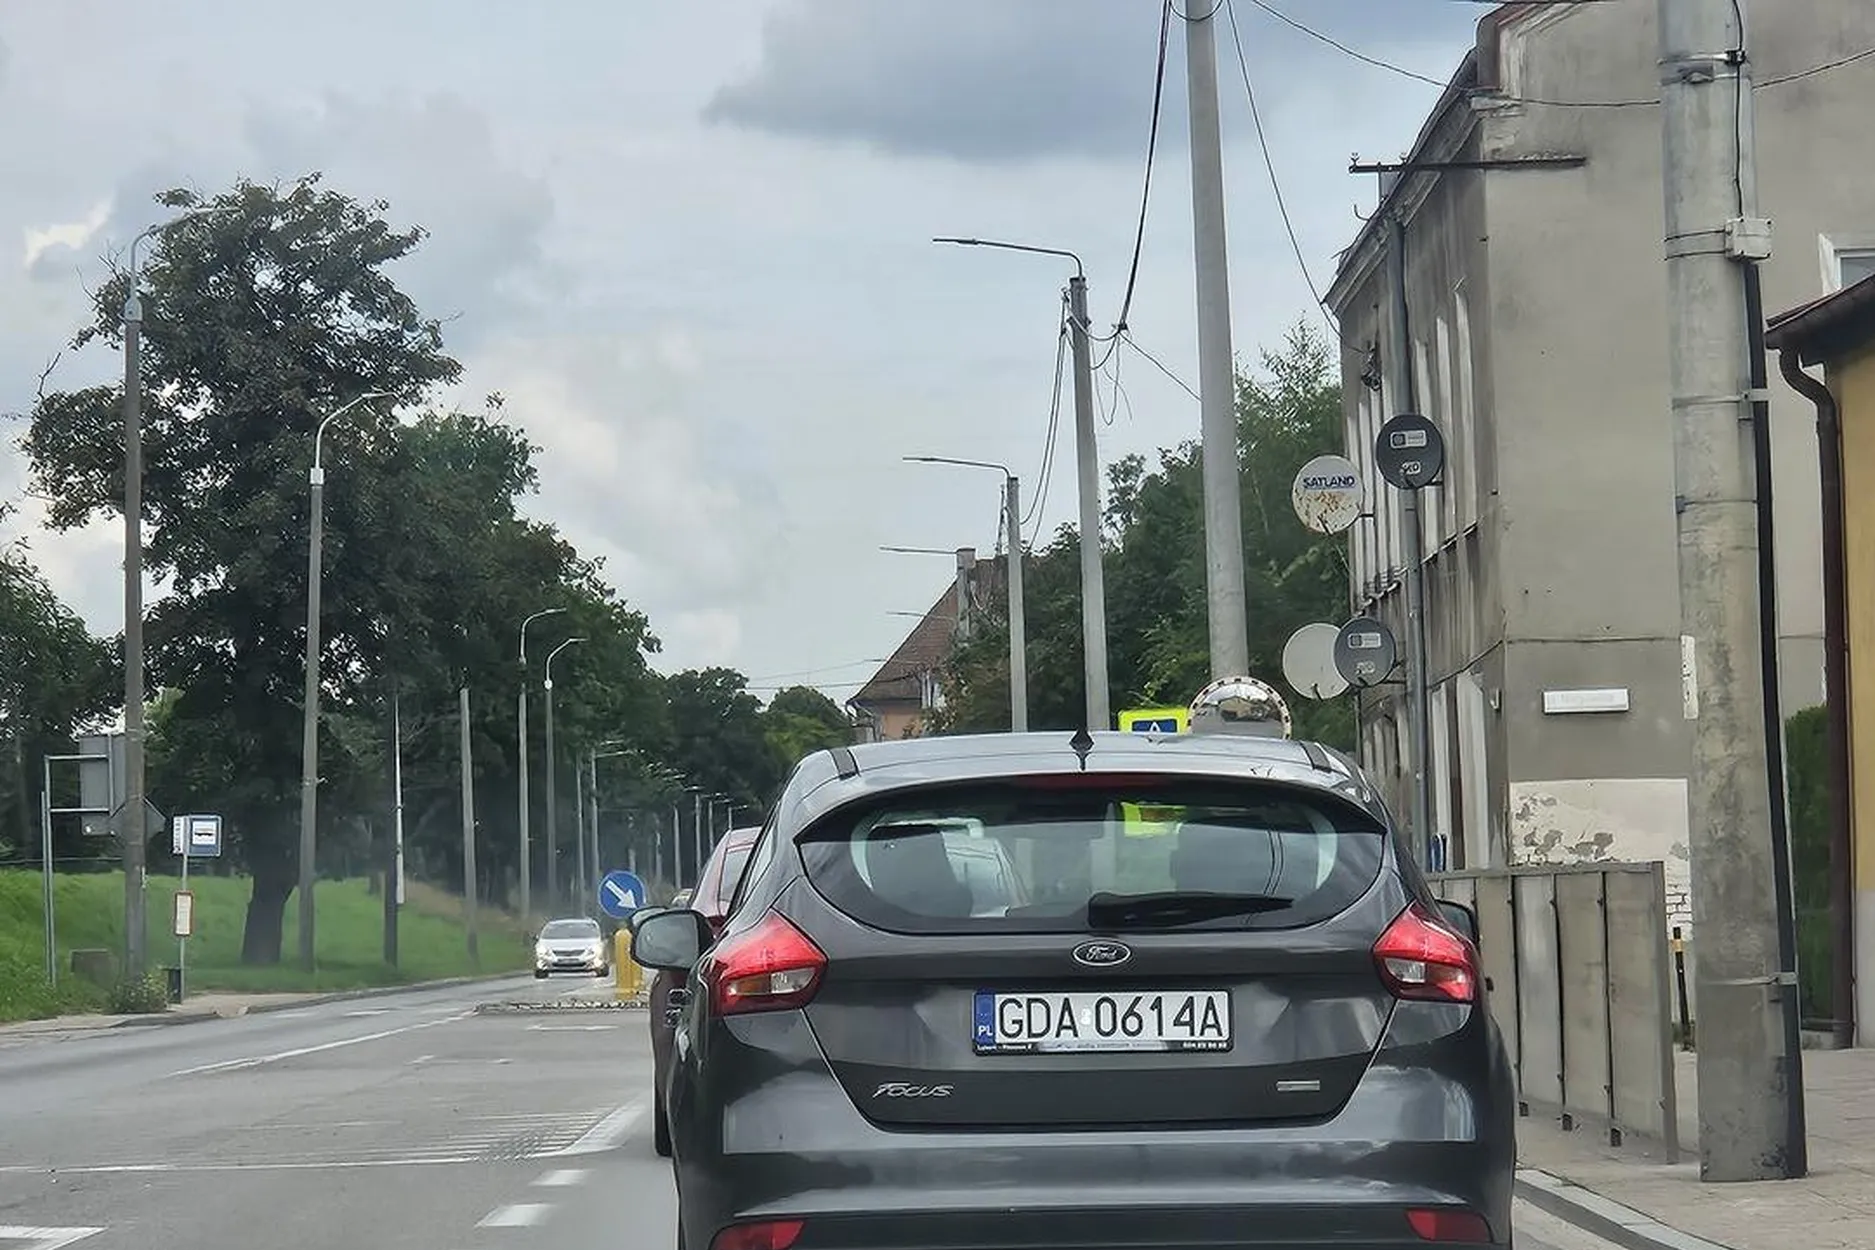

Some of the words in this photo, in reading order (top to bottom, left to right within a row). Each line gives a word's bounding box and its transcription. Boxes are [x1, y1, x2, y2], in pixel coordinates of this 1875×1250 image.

[1303, 475, 1355, 488] SATLAND
[1086, 945, 1117, 960] Ford
[999, 997, 1079, 1039] GDA
[1095, 995, 1223, 1037] 0614A
[978, 1025, 993, 1036] PL
